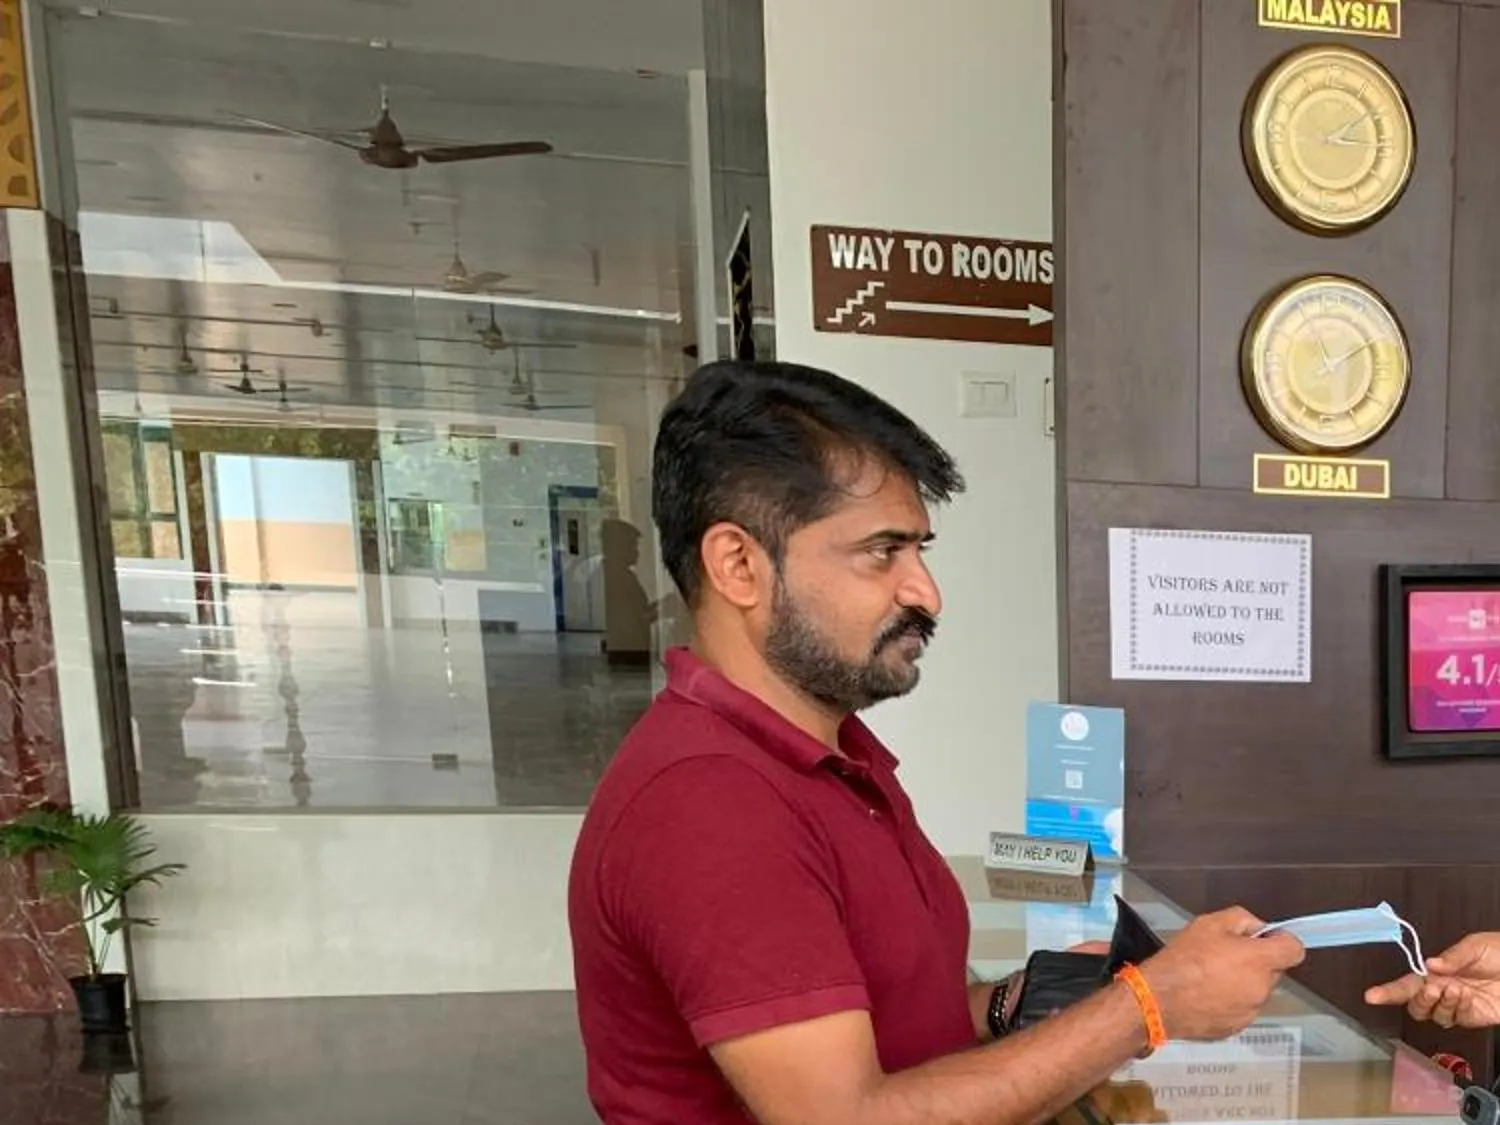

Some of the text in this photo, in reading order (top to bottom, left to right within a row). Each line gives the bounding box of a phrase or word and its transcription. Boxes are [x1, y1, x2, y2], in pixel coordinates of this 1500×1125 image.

[1267, 0, 1391, 30] MALAYSIA
[828, 233, 1054, 285] WAY TO ROOMS
[1284, 463, 1358, 491] DUBAI
[1147, 574, 1290, 596] VISITORS ARE NOT
[1152, 602, 1285, 622] ALLOWED TO THE
[1192, 631, 1245, 647] ROOMS
